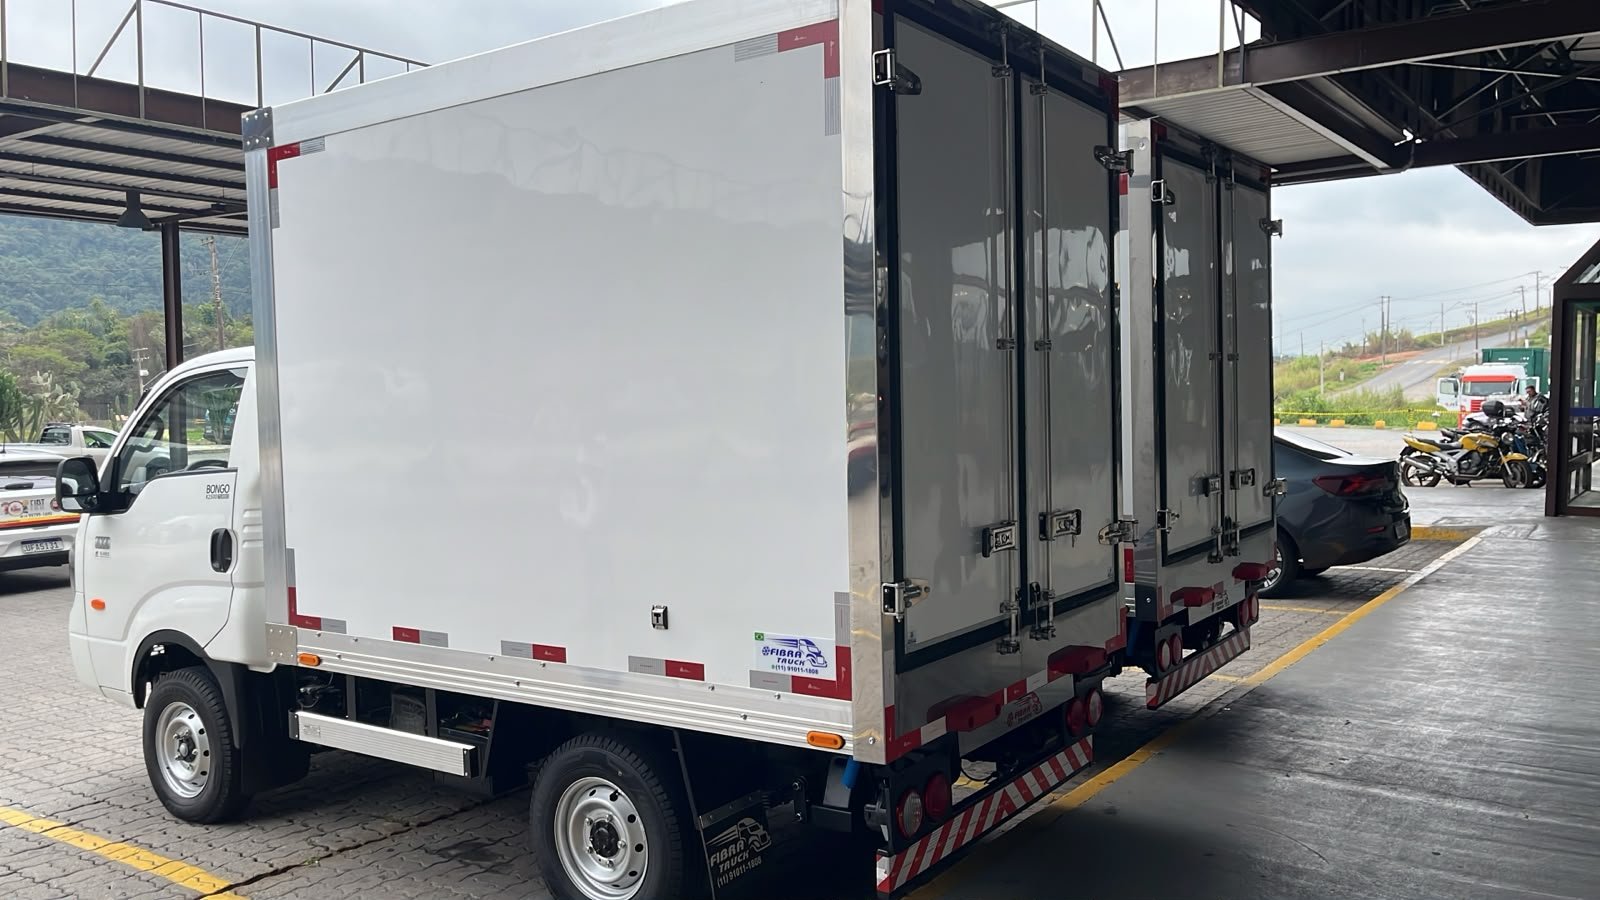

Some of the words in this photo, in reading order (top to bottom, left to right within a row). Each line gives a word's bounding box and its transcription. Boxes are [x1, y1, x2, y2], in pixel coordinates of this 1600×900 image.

[206, 484, 230, 494] BONGO
[770, 648, 802, 659] FIBRA
[777, 657, 805, 666] TRUCK
[775, 664, 786, 672] (11)
[710, 840, 744, 867] FIBRA
[719, 849, 750, 873] TRUCK
